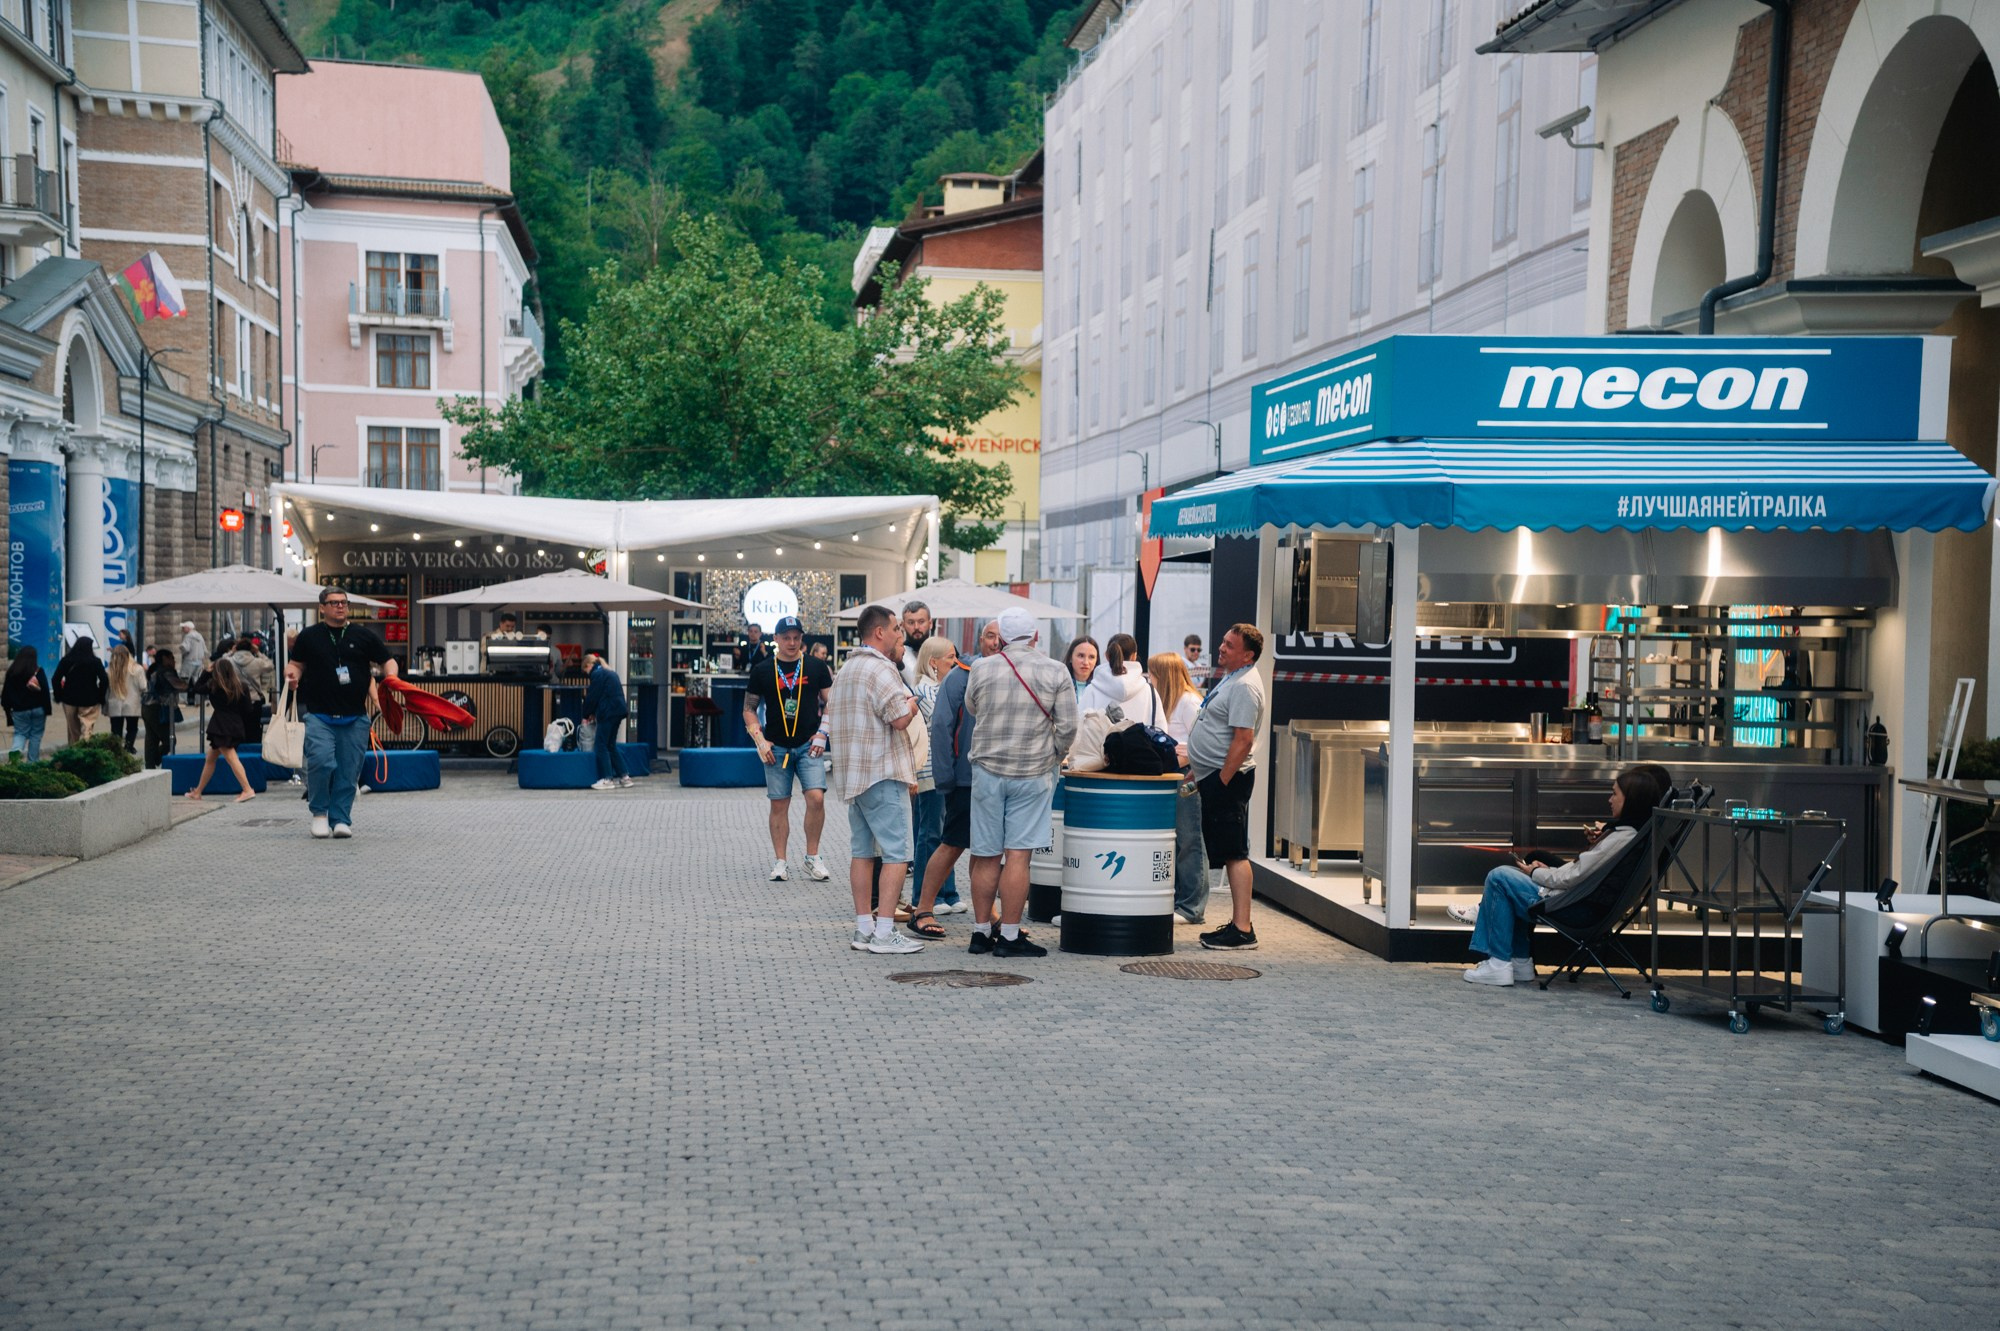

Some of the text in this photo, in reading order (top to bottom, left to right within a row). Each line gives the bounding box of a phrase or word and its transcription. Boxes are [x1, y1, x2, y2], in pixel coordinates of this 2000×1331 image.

[1315, 372, 1372, 427] mecon
[1499, 365, 1809, 411] mecon
[1617, 491, 1827, 519] #ЛУЧШАЯНЕЙТРАЛКА
[343, 547, 406, 569] CAFFÈ
[411, 551, 519, 570] VERGNANO
[525, 552, 565, 569] 1882
[752, 600, 788, 613] Rich
